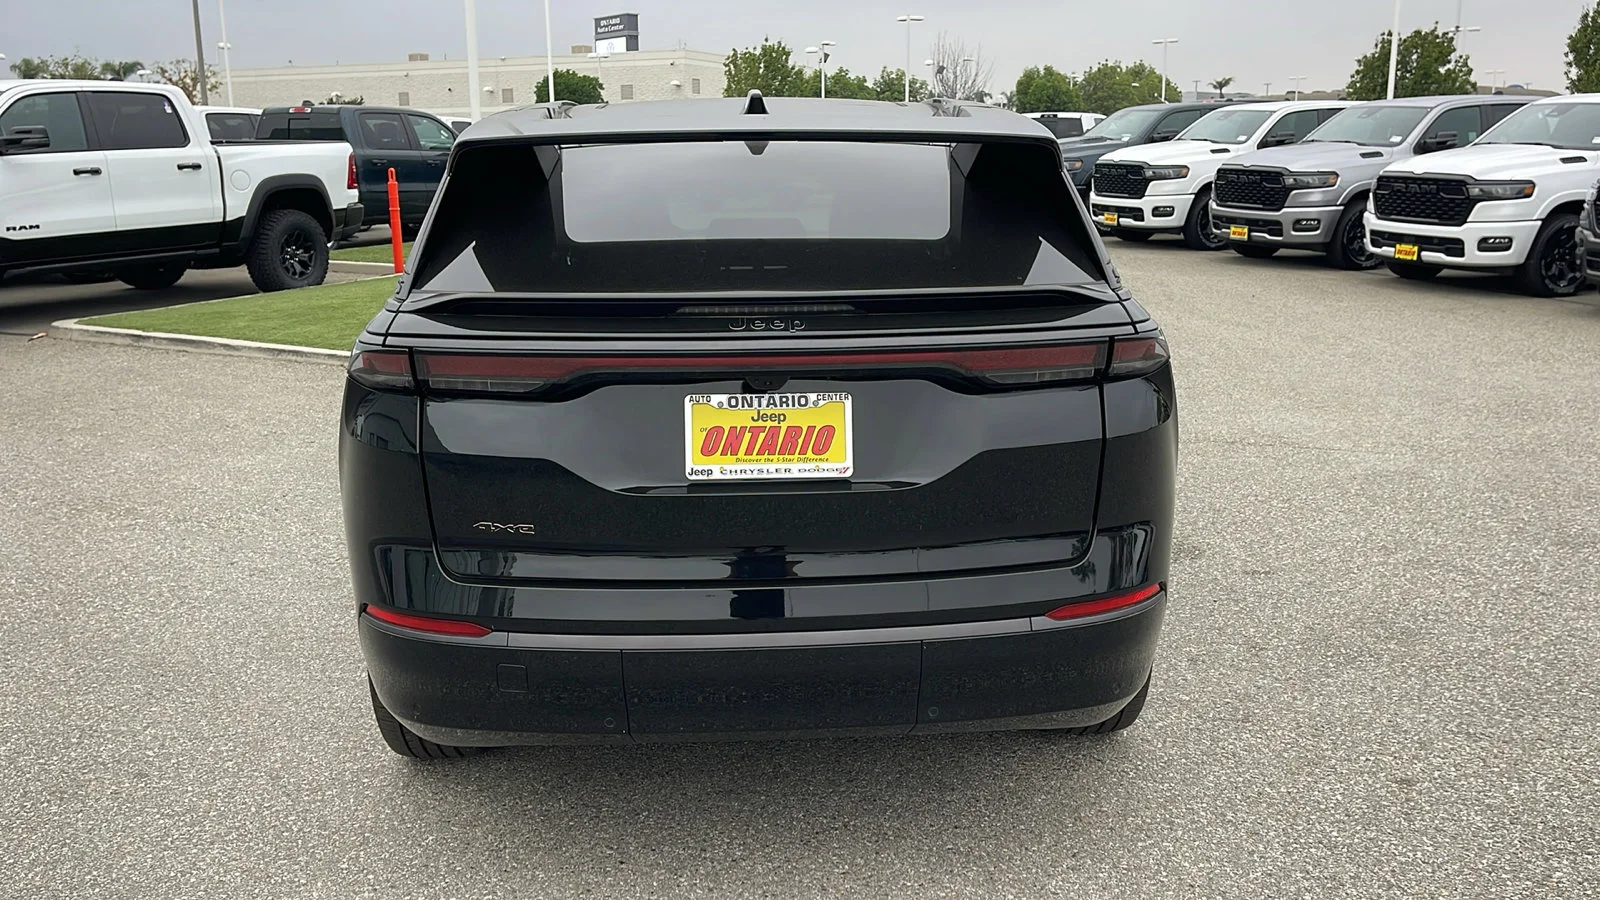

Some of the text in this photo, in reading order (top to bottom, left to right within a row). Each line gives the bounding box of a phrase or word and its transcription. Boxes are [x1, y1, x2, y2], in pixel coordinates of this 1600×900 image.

[1392, 183, 1438, 193] RAM
[6, 224, 40, 232] RAM
[729, 317, 806, 332] Jeep
[689, 393, 850, 409] AUTO ONTARIO CENTER
[751, 410, 787, 424] Jeep
[700, 425, 836, 457] ONTARIO
[688, 467, 844, 477] Jeep CHRYSLER DODGE
